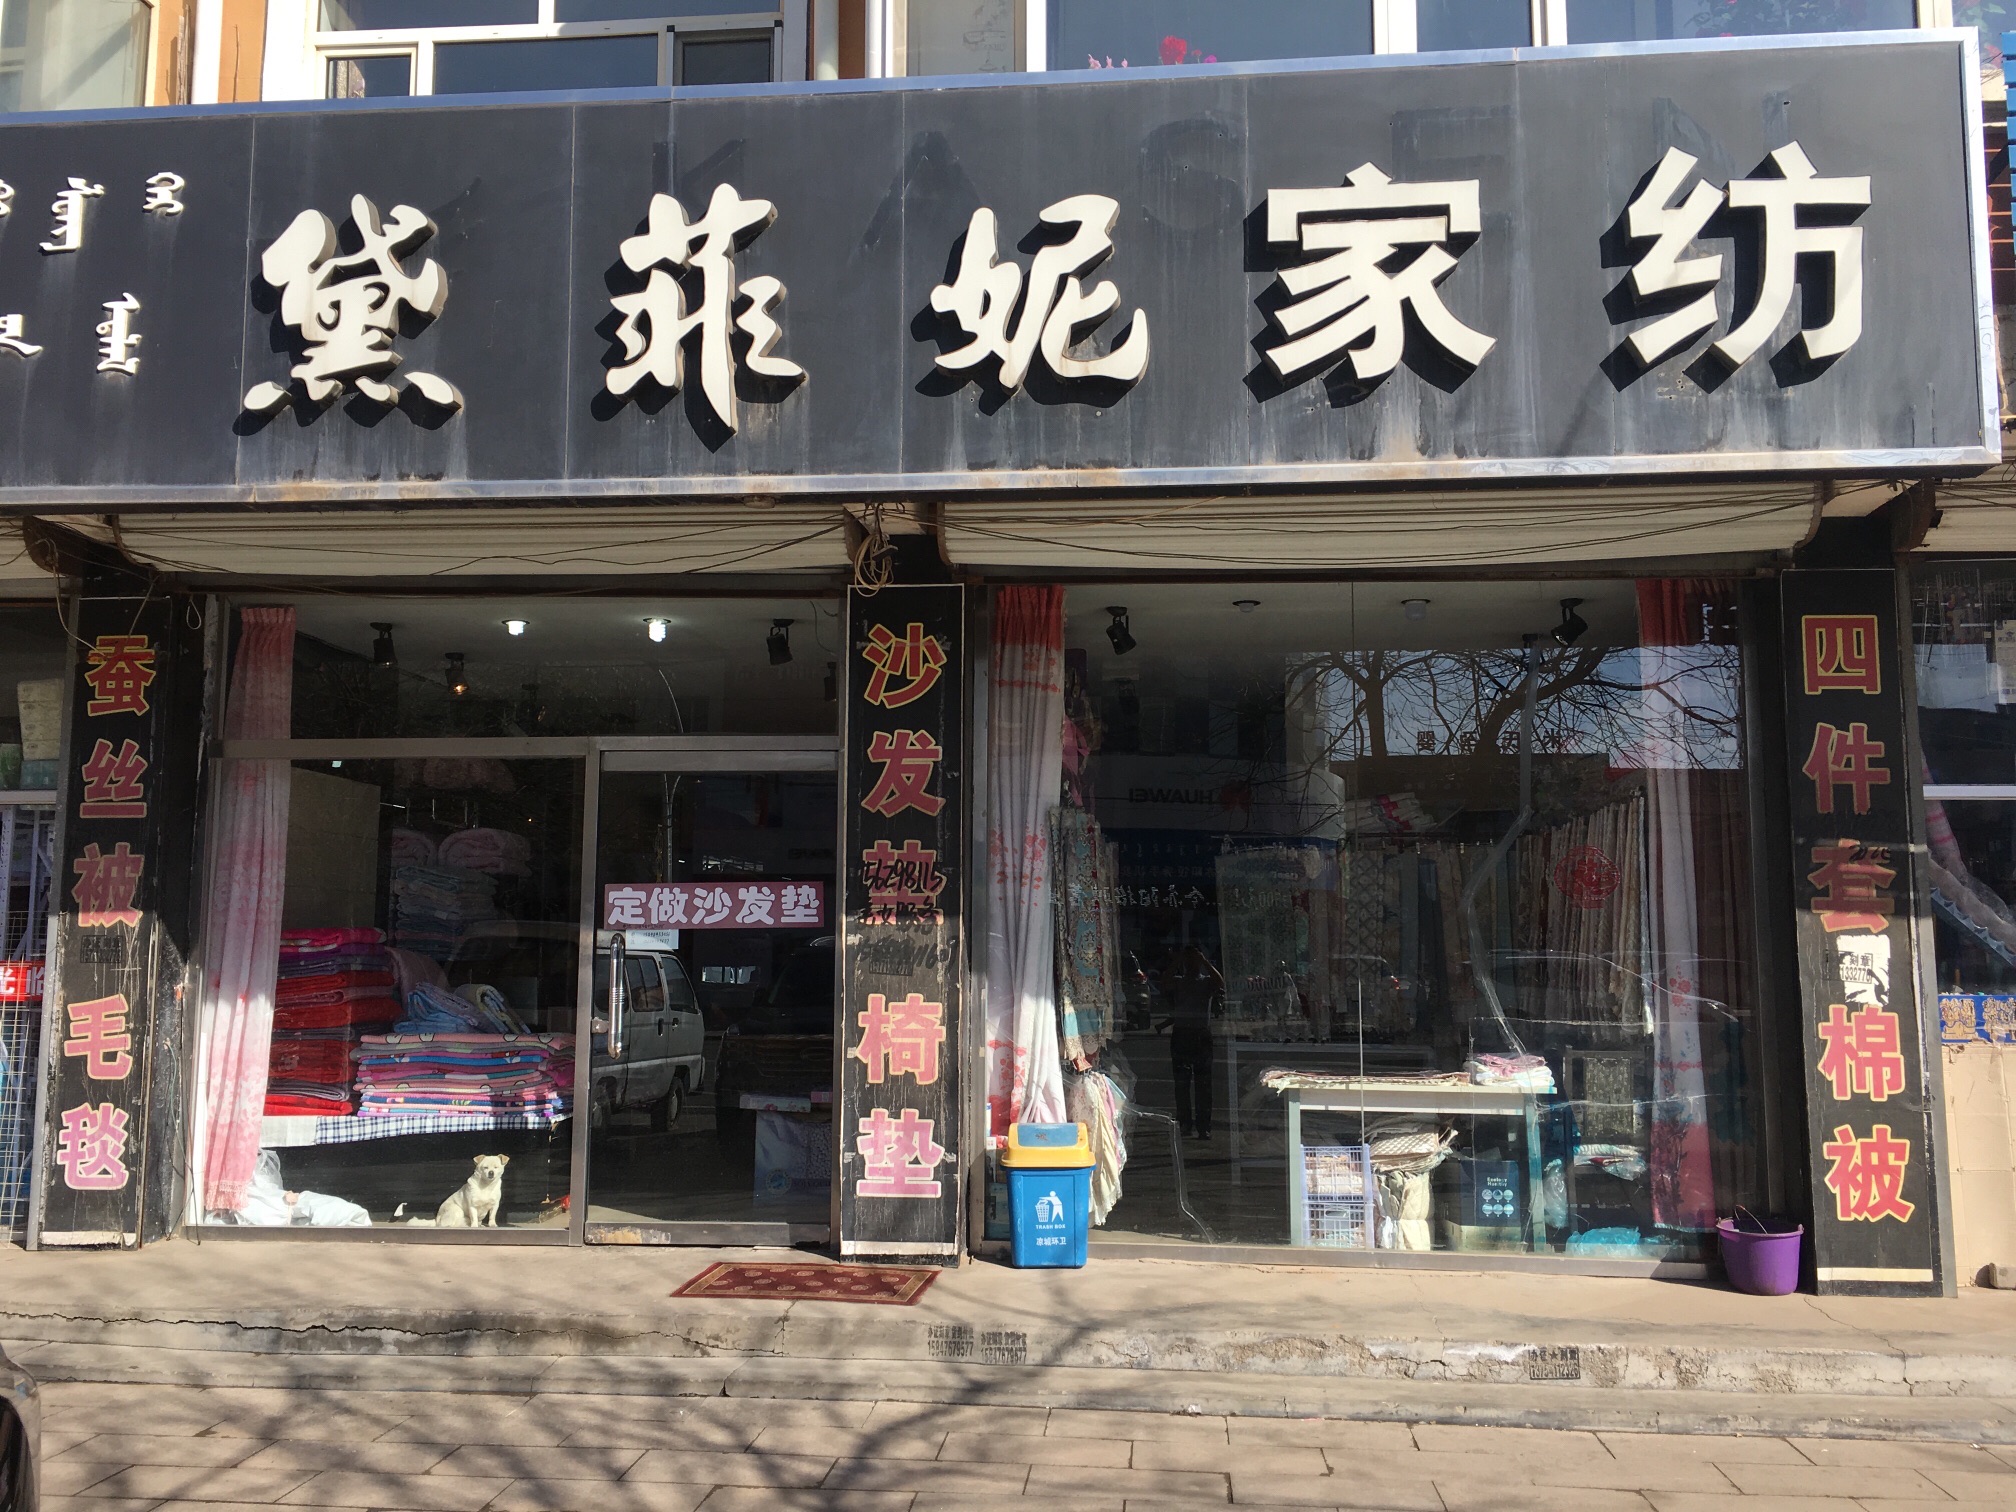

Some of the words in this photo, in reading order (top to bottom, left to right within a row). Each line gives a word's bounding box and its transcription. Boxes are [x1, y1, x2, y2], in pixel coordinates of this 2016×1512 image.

[243, 140, 1873, 433] 黛菲妮家纺
[72, 635, 155, 929] 蚕丝被
[860, 621, 948, 926] 沙发垫
[1801, 614, 1896, 933] 四件套
[607, 884, 820, 925] 定做沙发垫
[58, 995, 132, 1191] 毛毯
[856, 992, 947, 1199] 椅垫
[1818, 1003, 1911, 1223] 棉被
[1036, 1236, 1067, 1246] 凉城环卫
